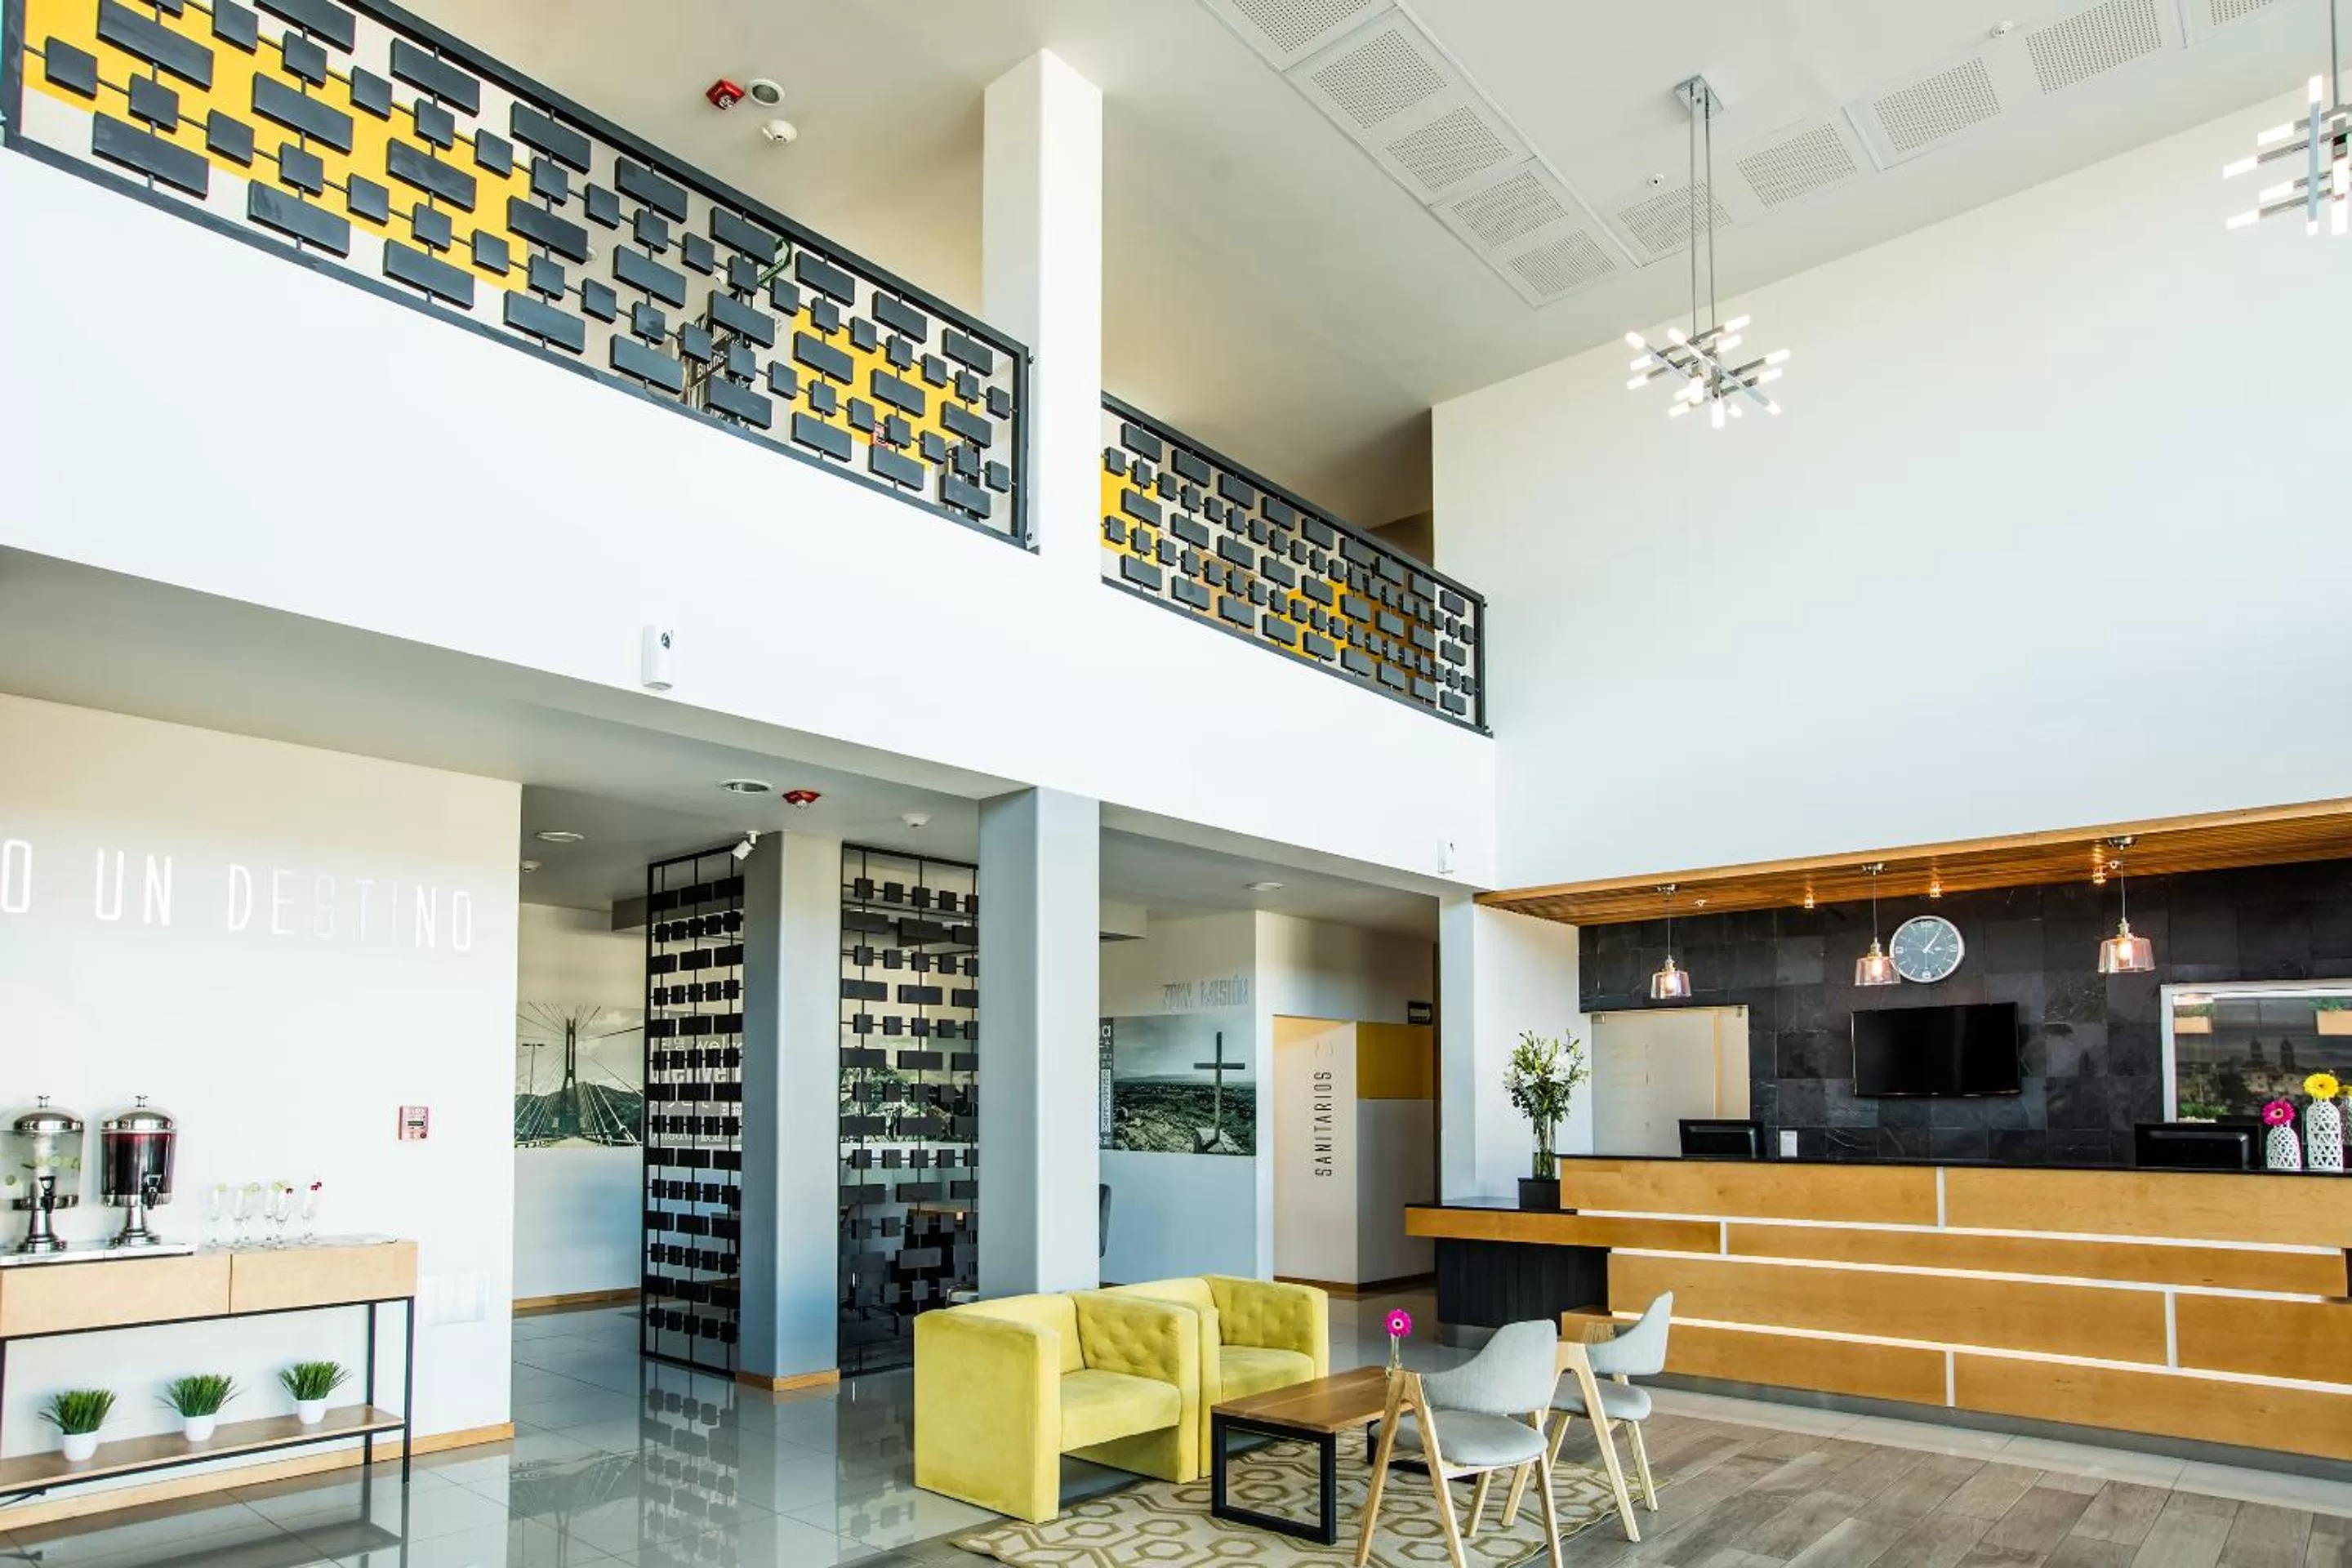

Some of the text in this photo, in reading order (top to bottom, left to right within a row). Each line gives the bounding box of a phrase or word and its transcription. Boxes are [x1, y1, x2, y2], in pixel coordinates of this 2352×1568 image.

[2, 840, 472, 951] O UN DESTINO
[1313, 1071, 1333, 1177] SANITARIOS
